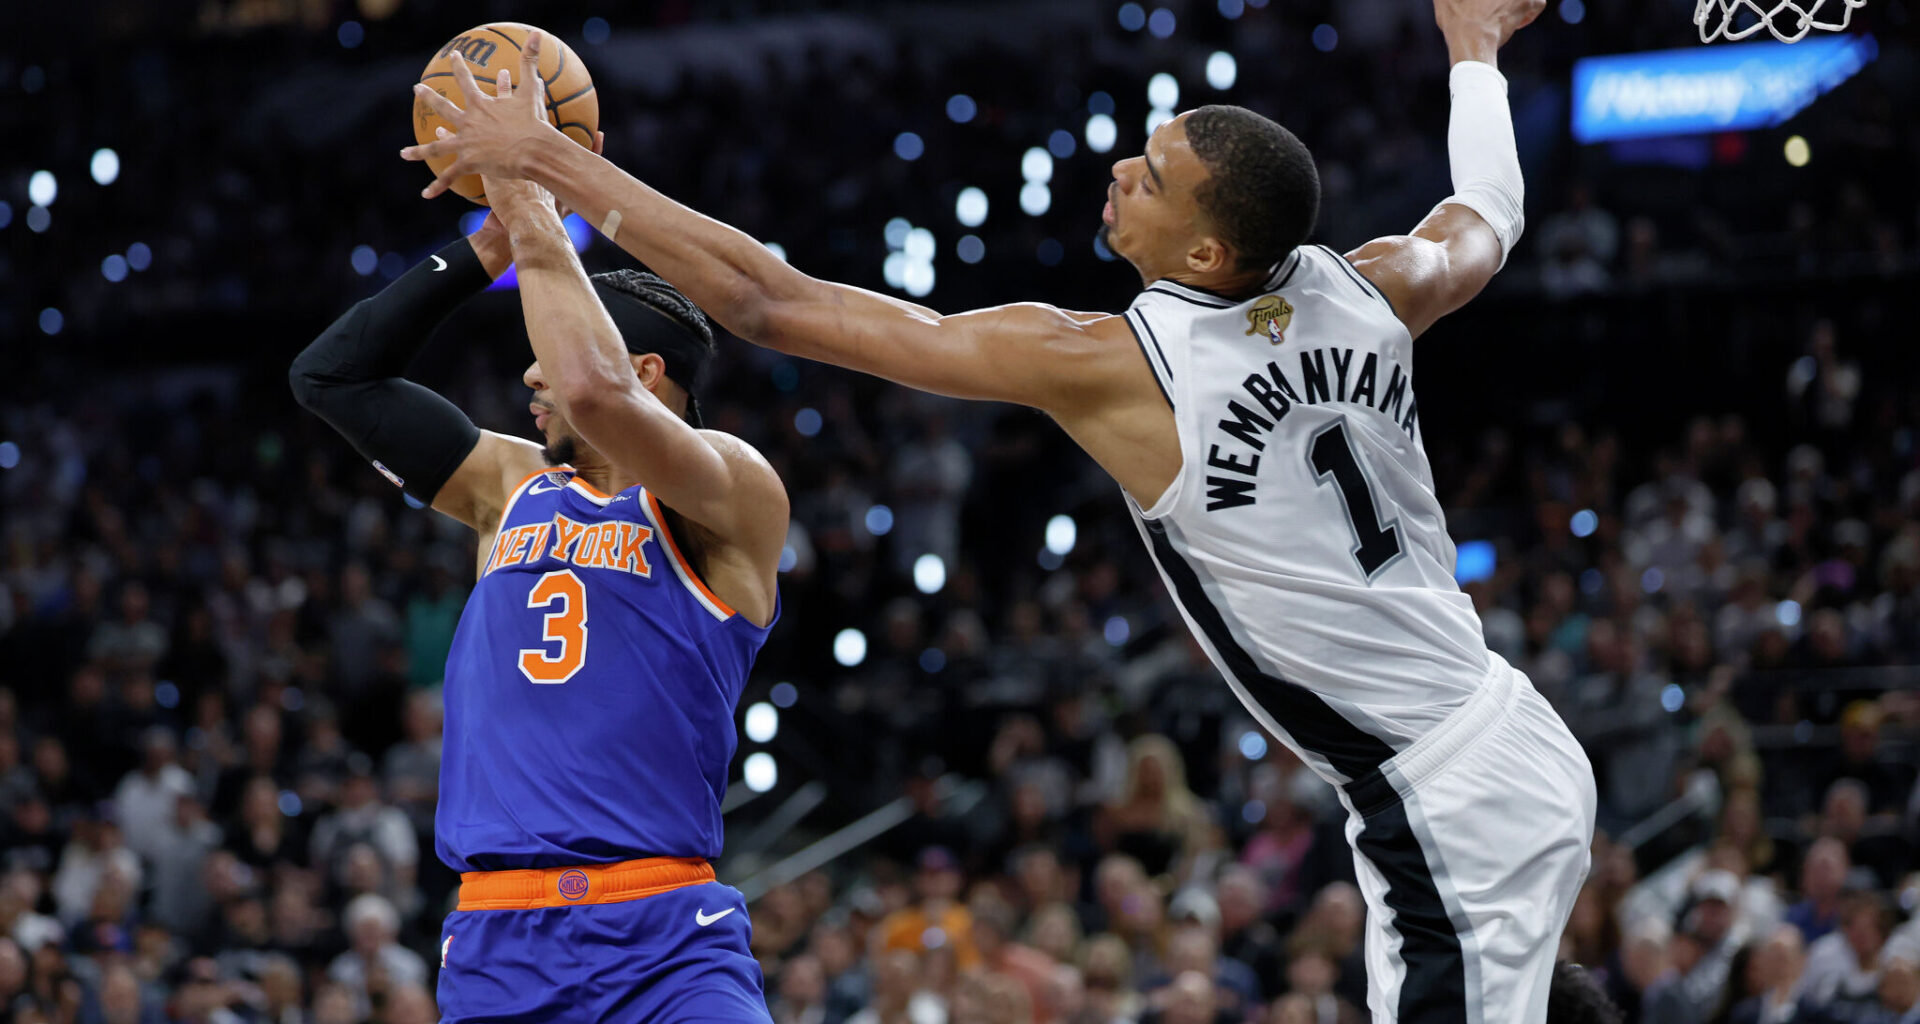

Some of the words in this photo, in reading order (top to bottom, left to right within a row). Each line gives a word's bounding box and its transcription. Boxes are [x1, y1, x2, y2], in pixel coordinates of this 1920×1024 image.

[1248, 301, 1292, 334] Finals
[548, 511, 654, 579] YORK
[1304, 414, 1408, 588] 1
[517, 568, 588, 684] 3
